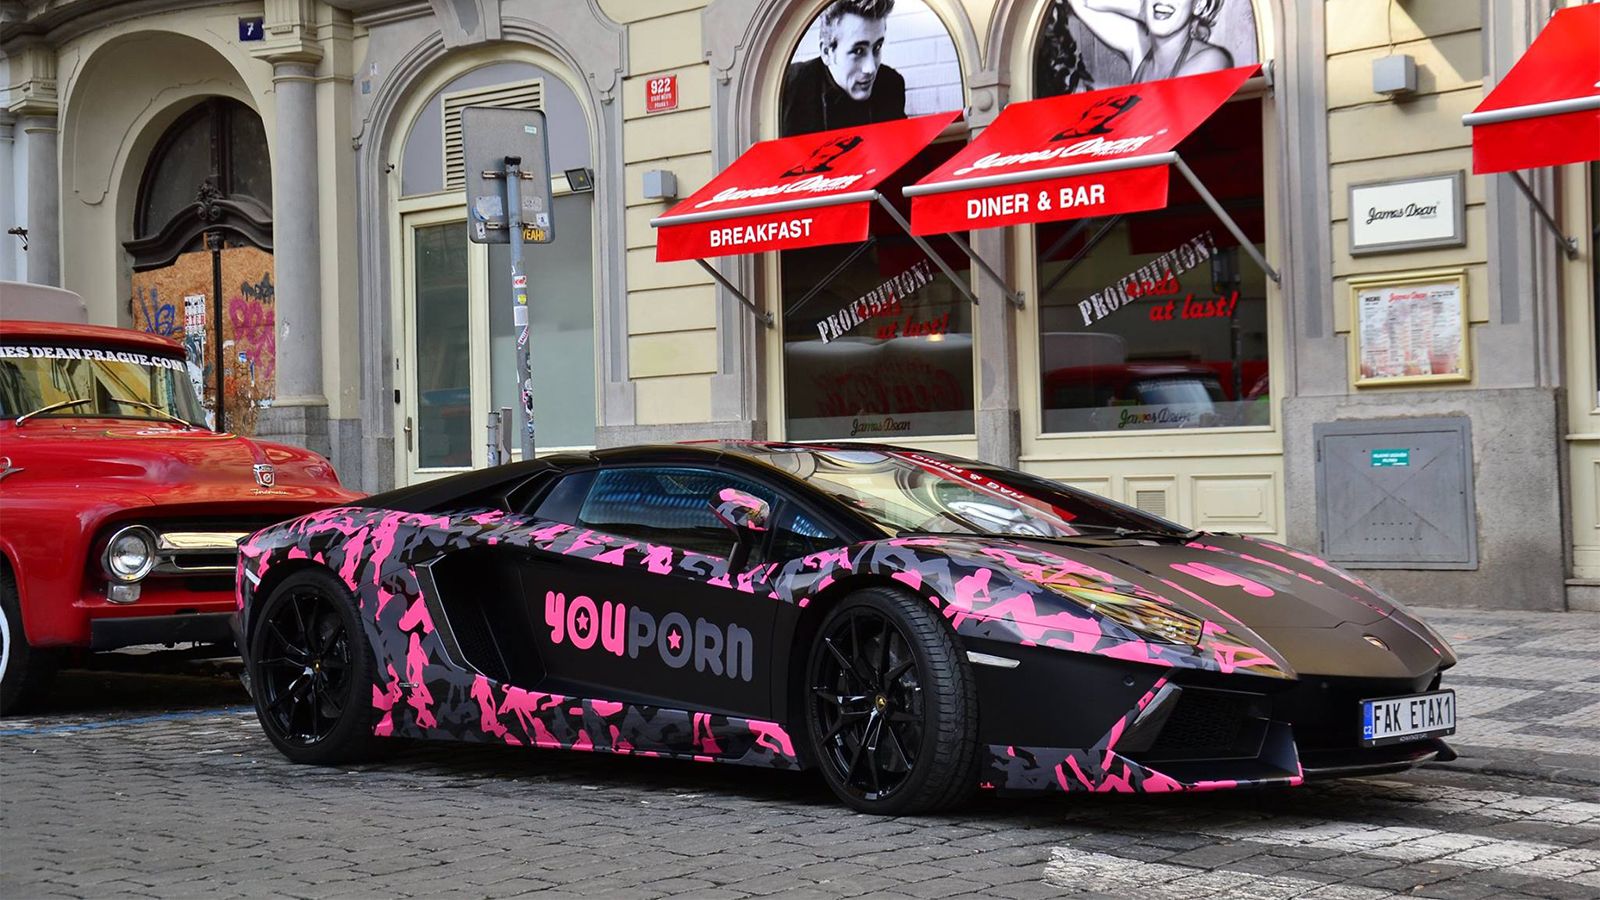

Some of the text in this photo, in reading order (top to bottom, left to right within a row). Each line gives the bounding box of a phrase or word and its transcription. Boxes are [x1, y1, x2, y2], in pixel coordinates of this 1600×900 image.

[246, 22, 254, 36] 7
[650, 78, 671, 94] 922
[966, 184, 1105, 220] DINER & BAR
[1366, 202, 1438, 225] James Dean
[709, 218, 813, 248] BREAKFAST
[1126, 268, 1180, 298] ends
[1149, 290, 1240, 321] at last!
[876, 311, 949, 340] at last!
[29, 346, 83, 360] DEAN
[81, 348, 185, 373] PRAGUE.COM
[851, 417, 911, 437] James Dean
[1374, 696, 1451, 734] FAK ETAX1
[1363, 725, 1373, 735] CZ
